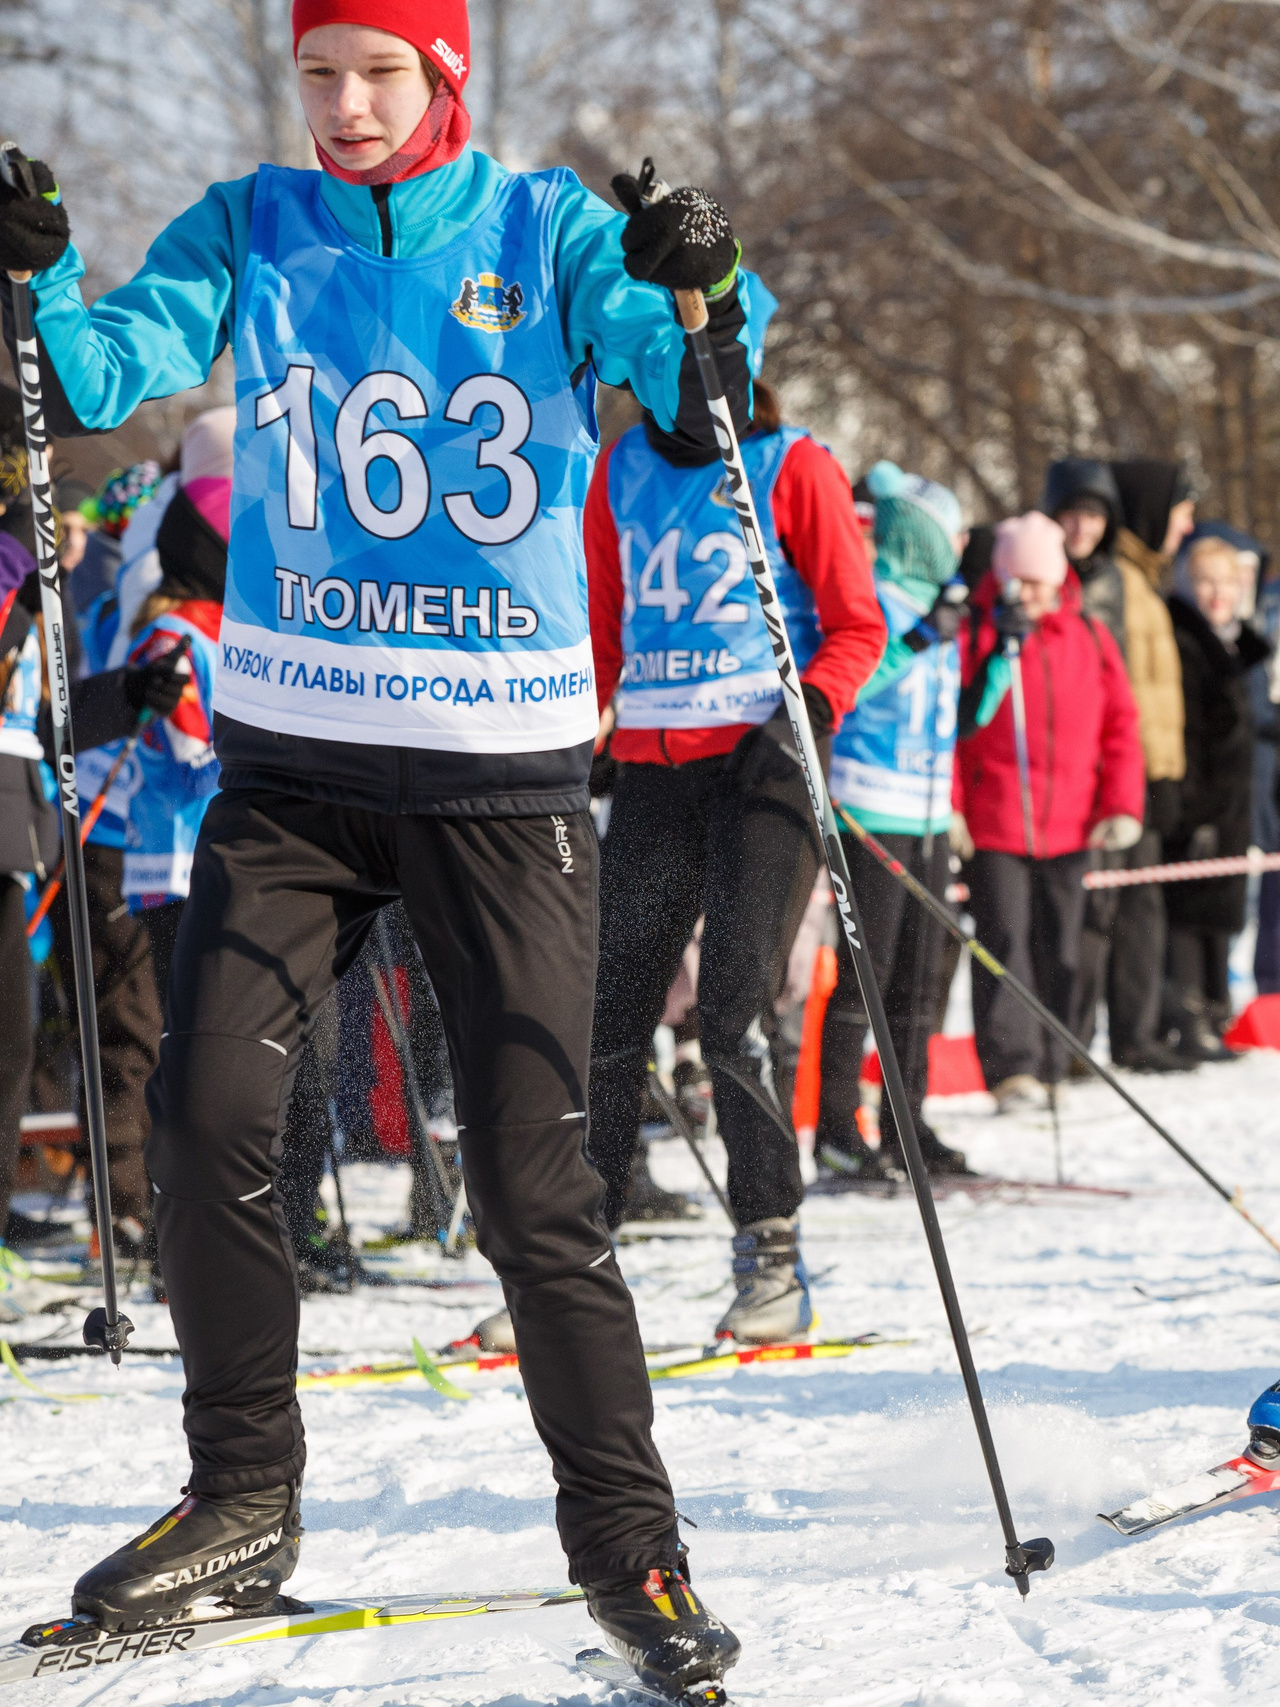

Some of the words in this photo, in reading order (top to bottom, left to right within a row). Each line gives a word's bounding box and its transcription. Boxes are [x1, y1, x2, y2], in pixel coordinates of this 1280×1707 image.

[254, 363, 540, 547] 163
[274, 566, 539, 639] ТЮМЕНЬ
[221, 642, 275, 683] КУБОК
[279, 659, 366, 697] ГЛАВЫ
[375, 673, 495, 707] ГОРОДА
[624, 648, 742, 684] ЮМЕНЬ
[153, 1526, 283, 1593] SALOMON
[32, 1627, 196, 1678] FISCHER
